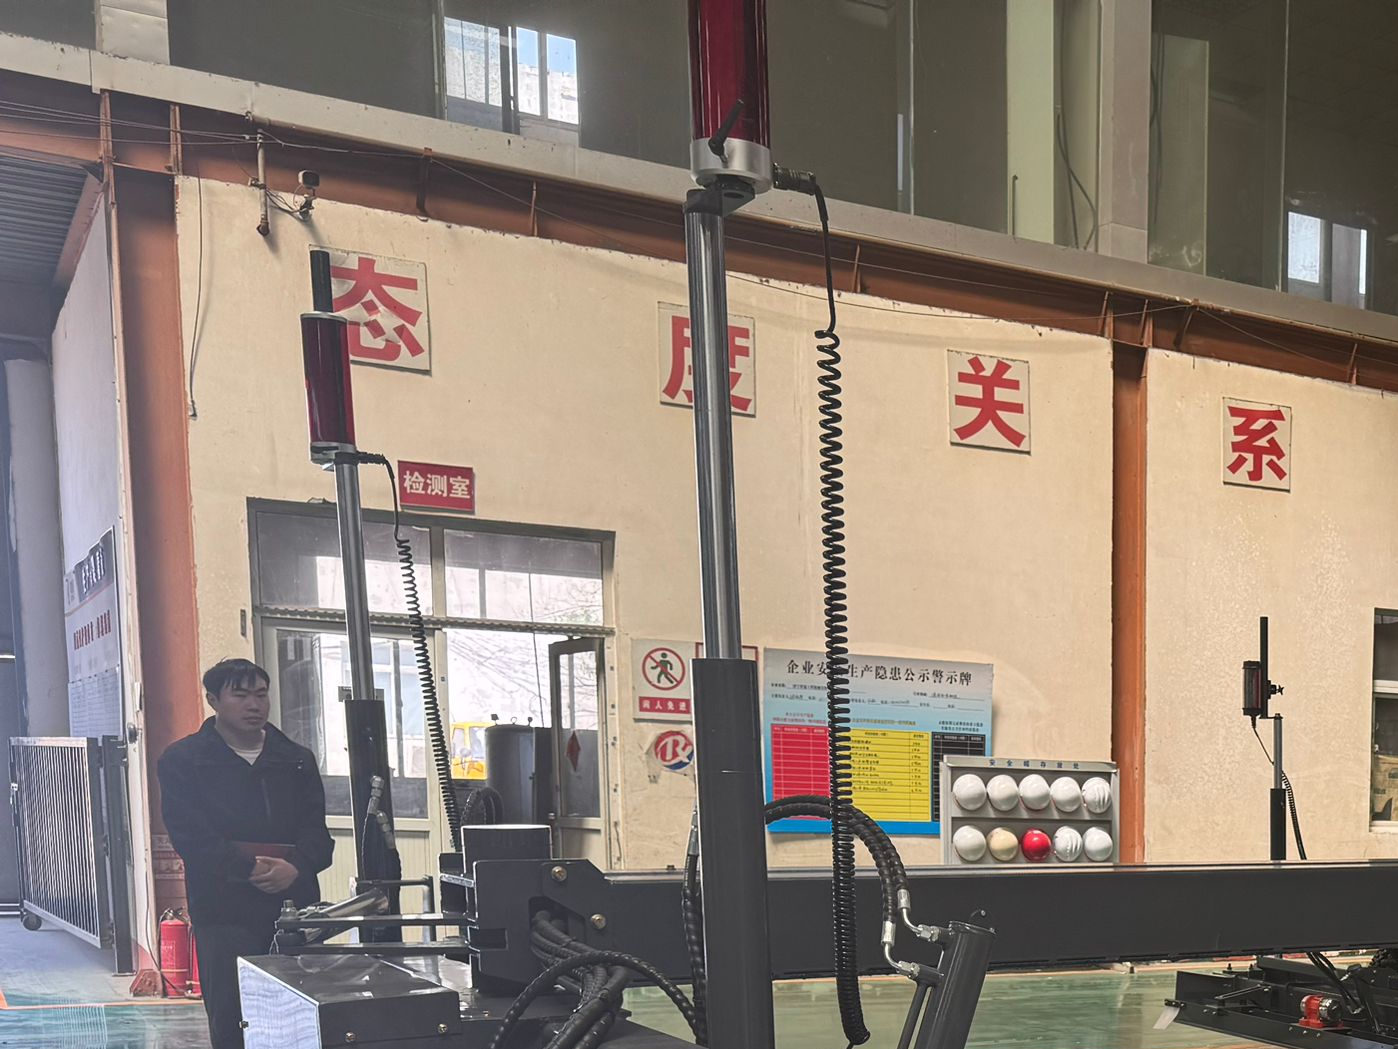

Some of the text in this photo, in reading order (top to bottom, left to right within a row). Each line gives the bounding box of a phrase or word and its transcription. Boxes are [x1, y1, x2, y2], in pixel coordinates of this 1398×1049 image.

[331, 256, 425, 361] 态
[662, 315, 752, 412] 度
[955, 357, 1028, 448] 关
[1227, 405, 1288, 482] 系
[403, 470, 471, 499] 检测室
[786, 659, 972, 686] 企业安生产隐患公示警示牌
